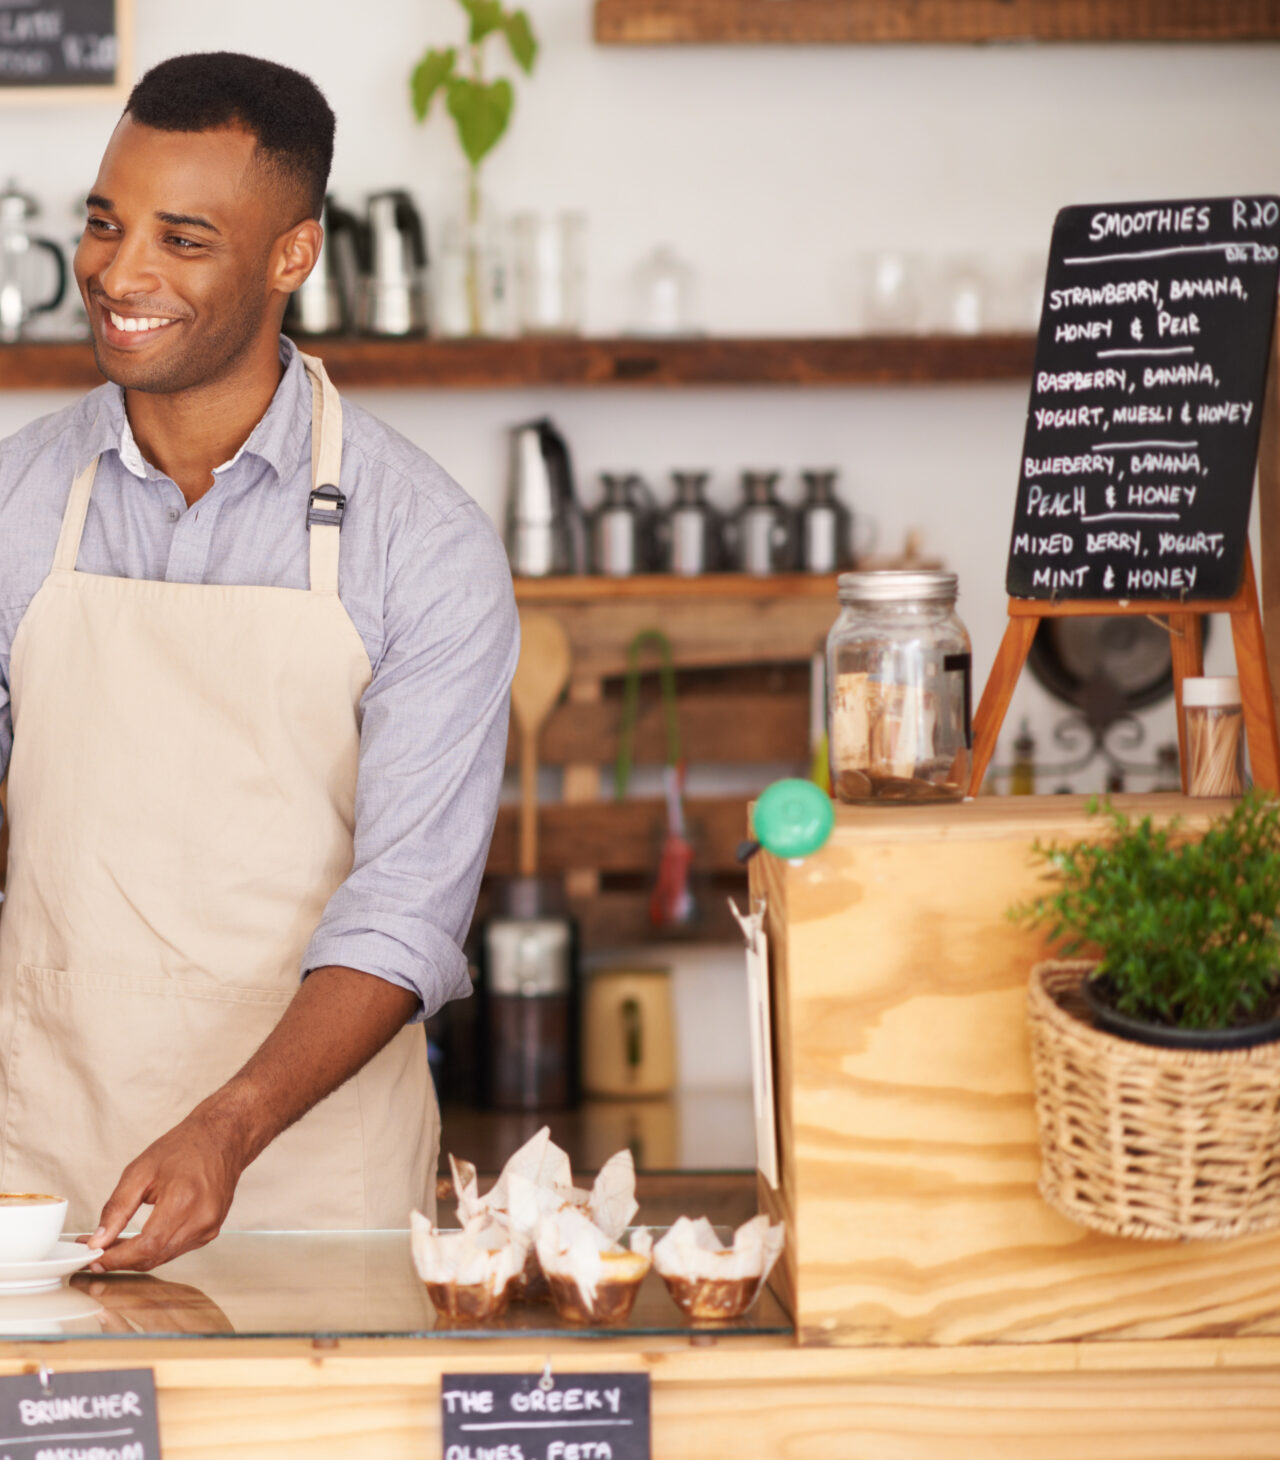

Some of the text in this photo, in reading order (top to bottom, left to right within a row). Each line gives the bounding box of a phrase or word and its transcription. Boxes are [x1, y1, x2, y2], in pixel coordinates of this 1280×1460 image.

[1088, 199, 1279, 240] SMOOTHIES R20
[1050, 277, 1247, 312] STRAWBERRY, BANANA,
[1055, 309, 1200, 342] HONEY & PEAR
[1037, 363, 1219, 393] RASPBERRY, BANANA,
[1113, 406, 1172, 423] MUESLI
[1197, 402, 1252, 424] HONEY
[1025, 453, 1208, 480] BLUEBERRY, BANANA,
[1027, 486, 1085, 516] PEACH
[1128, 485, 1196, 505] HONEY
[1014, 531, 1223, 557] MIXED BERRY, YOGURT,
[1033, 566, 1089, 588] MINT
[1128, 567, 1196, 590] HONEY
[19, 1392, 141, 1425] BRUNCHER
[442, 1388, 620, 1413] THE GREEKY
[548, 1441, 611, 1460] FETA
